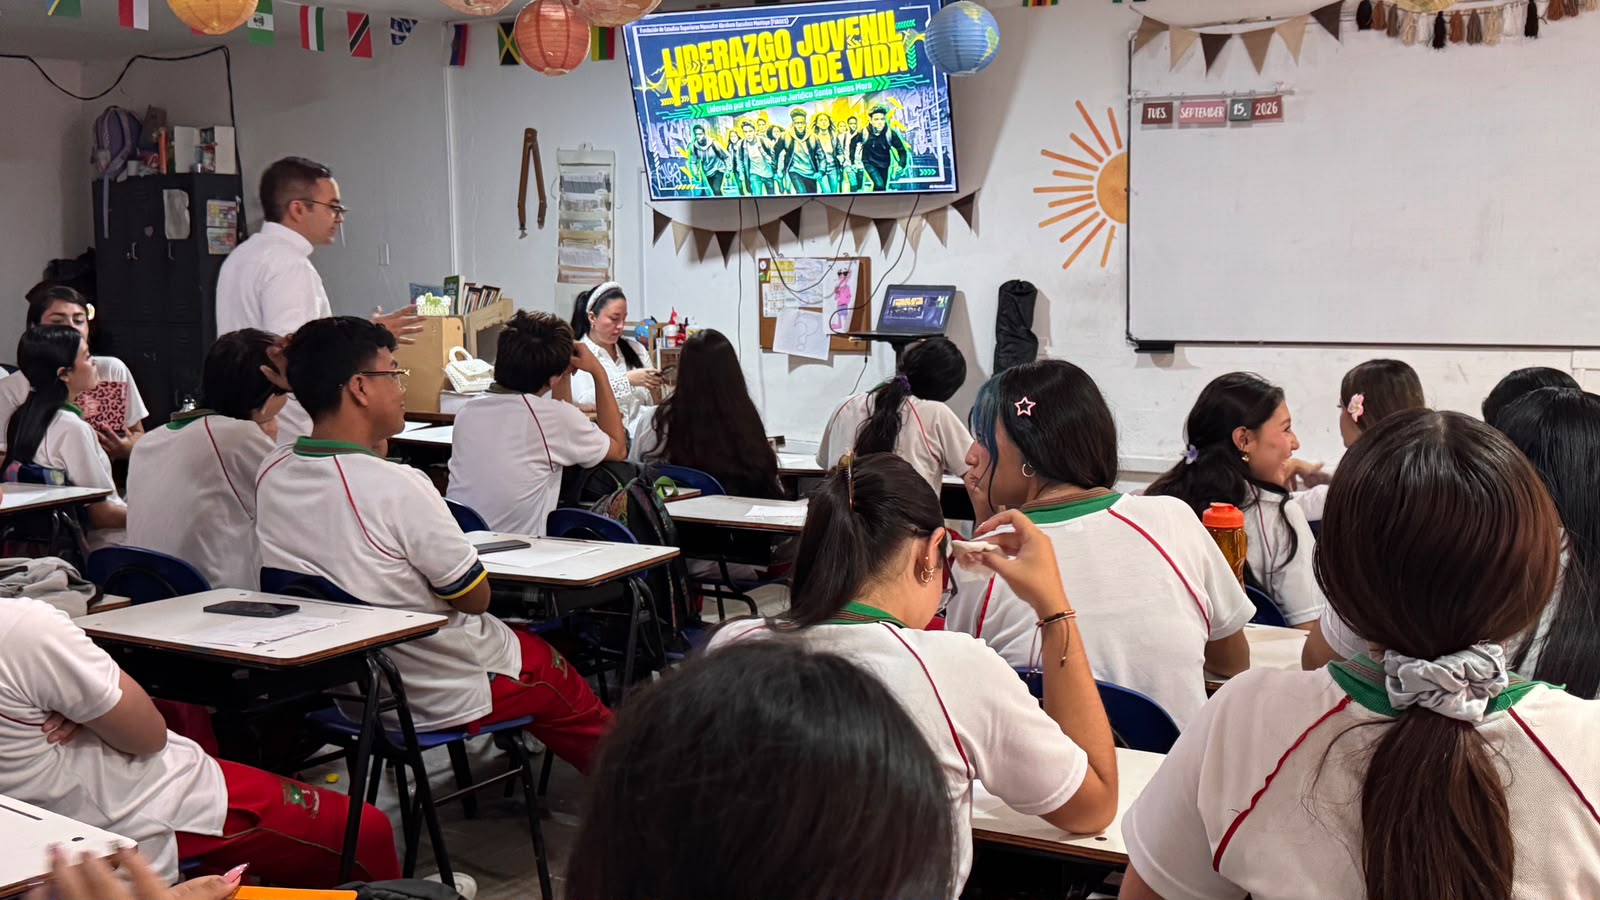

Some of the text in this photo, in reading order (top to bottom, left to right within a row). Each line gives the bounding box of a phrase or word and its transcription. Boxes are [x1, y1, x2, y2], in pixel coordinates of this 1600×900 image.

[661, 10, 903, 78] LIDERAZGO JUVENIL
[667, 39, 908, 106] Y PROYECTO DE VIDA
[733, 101, 744, 111] por
[751, 95, 787, 107] Consultorio
[1147, 102, 1278, 119] TUES. SEPTEMBER 15, 2026
